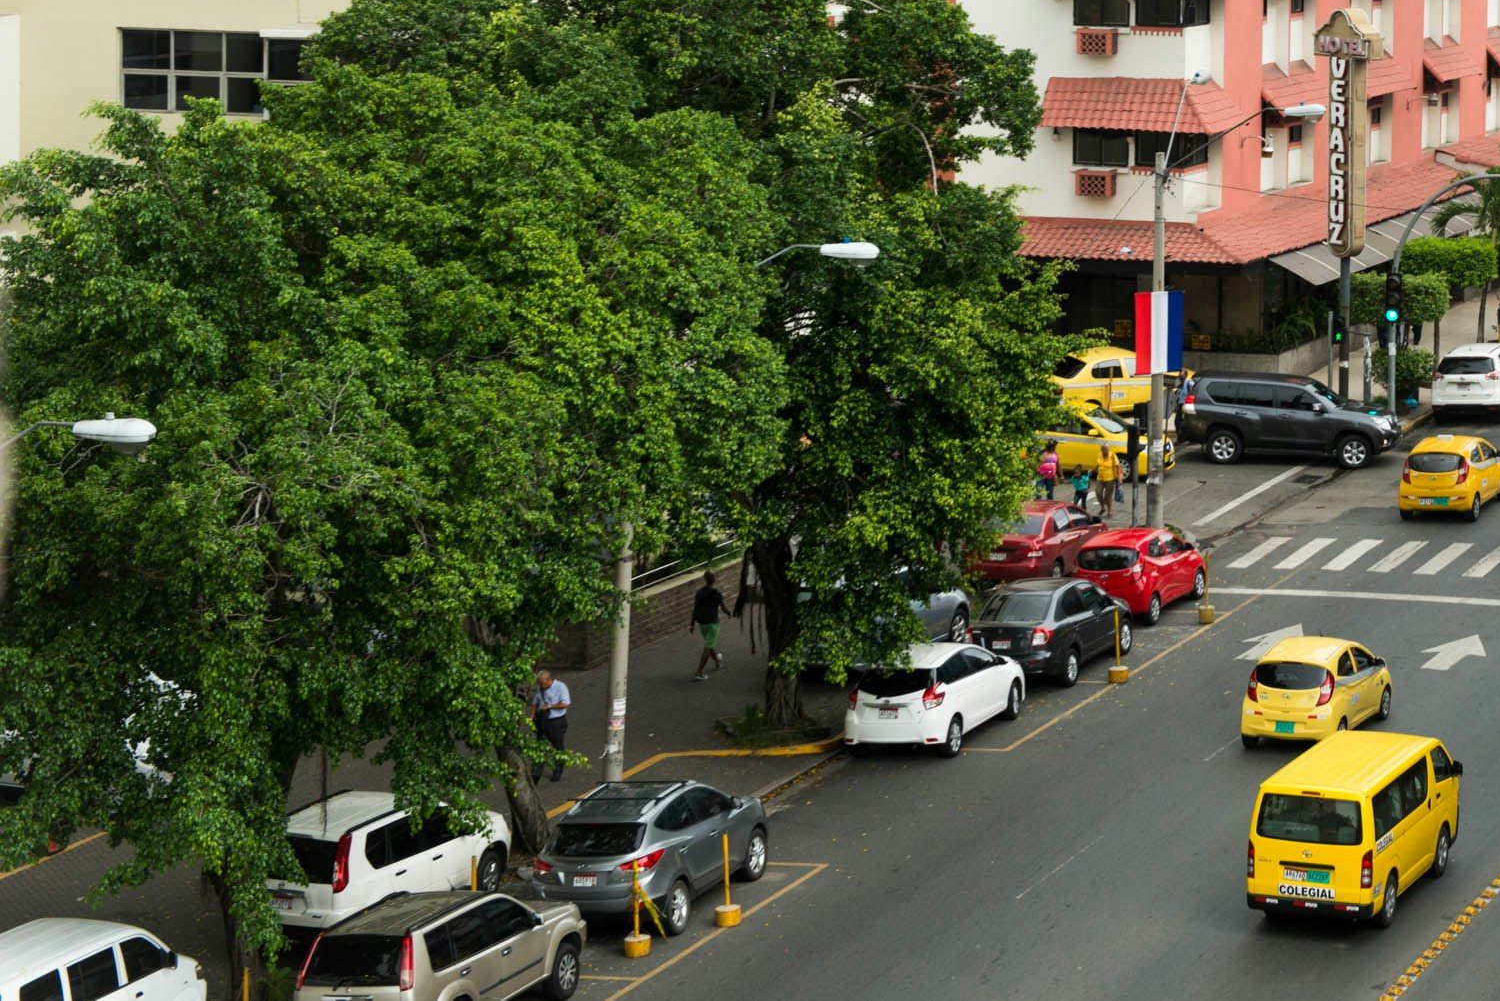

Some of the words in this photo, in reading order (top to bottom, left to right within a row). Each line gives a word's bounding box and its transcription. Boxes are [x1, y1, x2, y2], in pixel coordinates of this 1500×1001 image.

[1319, 35, 1365, 55] HOTEL
[1329, 56, 1346, 245] VERACRUZ
[1279, 884, 1335, 899] COLEGIAL
